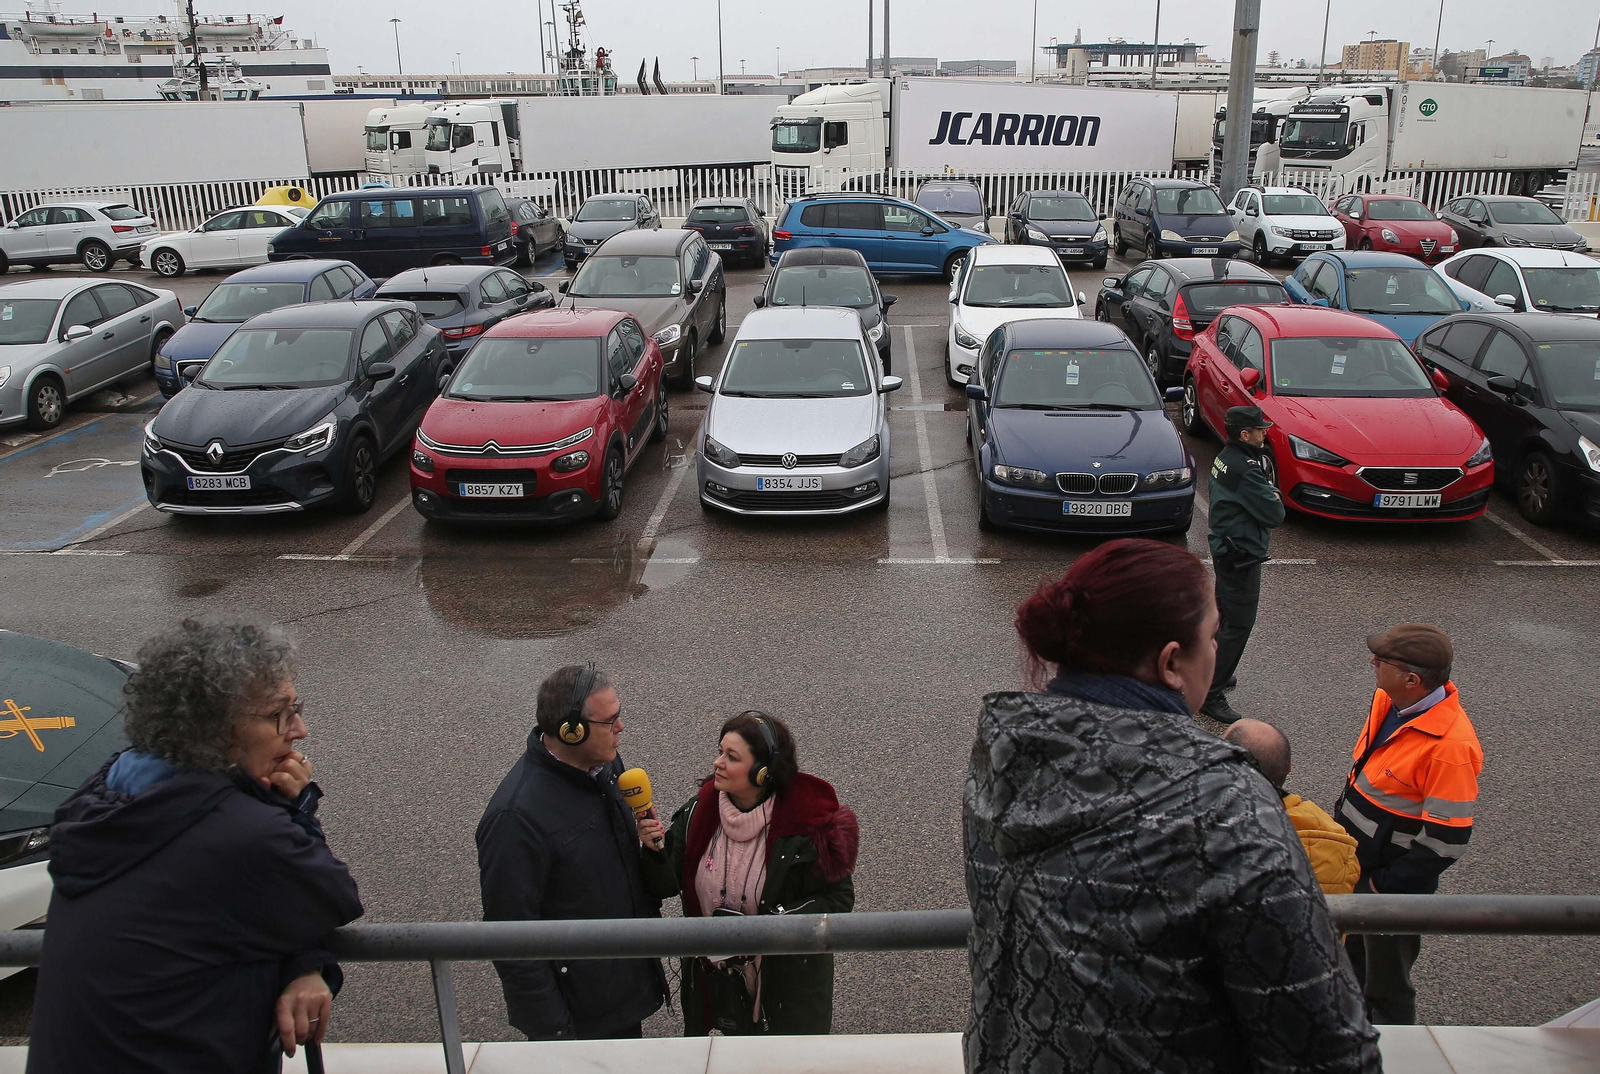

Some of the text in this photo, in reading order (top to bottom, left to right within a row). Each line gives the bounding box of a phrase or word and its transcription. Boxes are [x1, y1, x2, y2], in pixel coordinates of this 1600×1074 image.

[1420, 103, 1436, 112] GTO
[928, 111, 1101, 147] JCARRION
[194, 477, 247, 489] 8283 MCB
[764, 478, 819, 489] 8354 JJS
[467, 484, 520, 495] 8857 KZY
[1382, 495, 1439, 507] 9791 LWW
[1071, 503, 1129, 515] 9820 DBC
